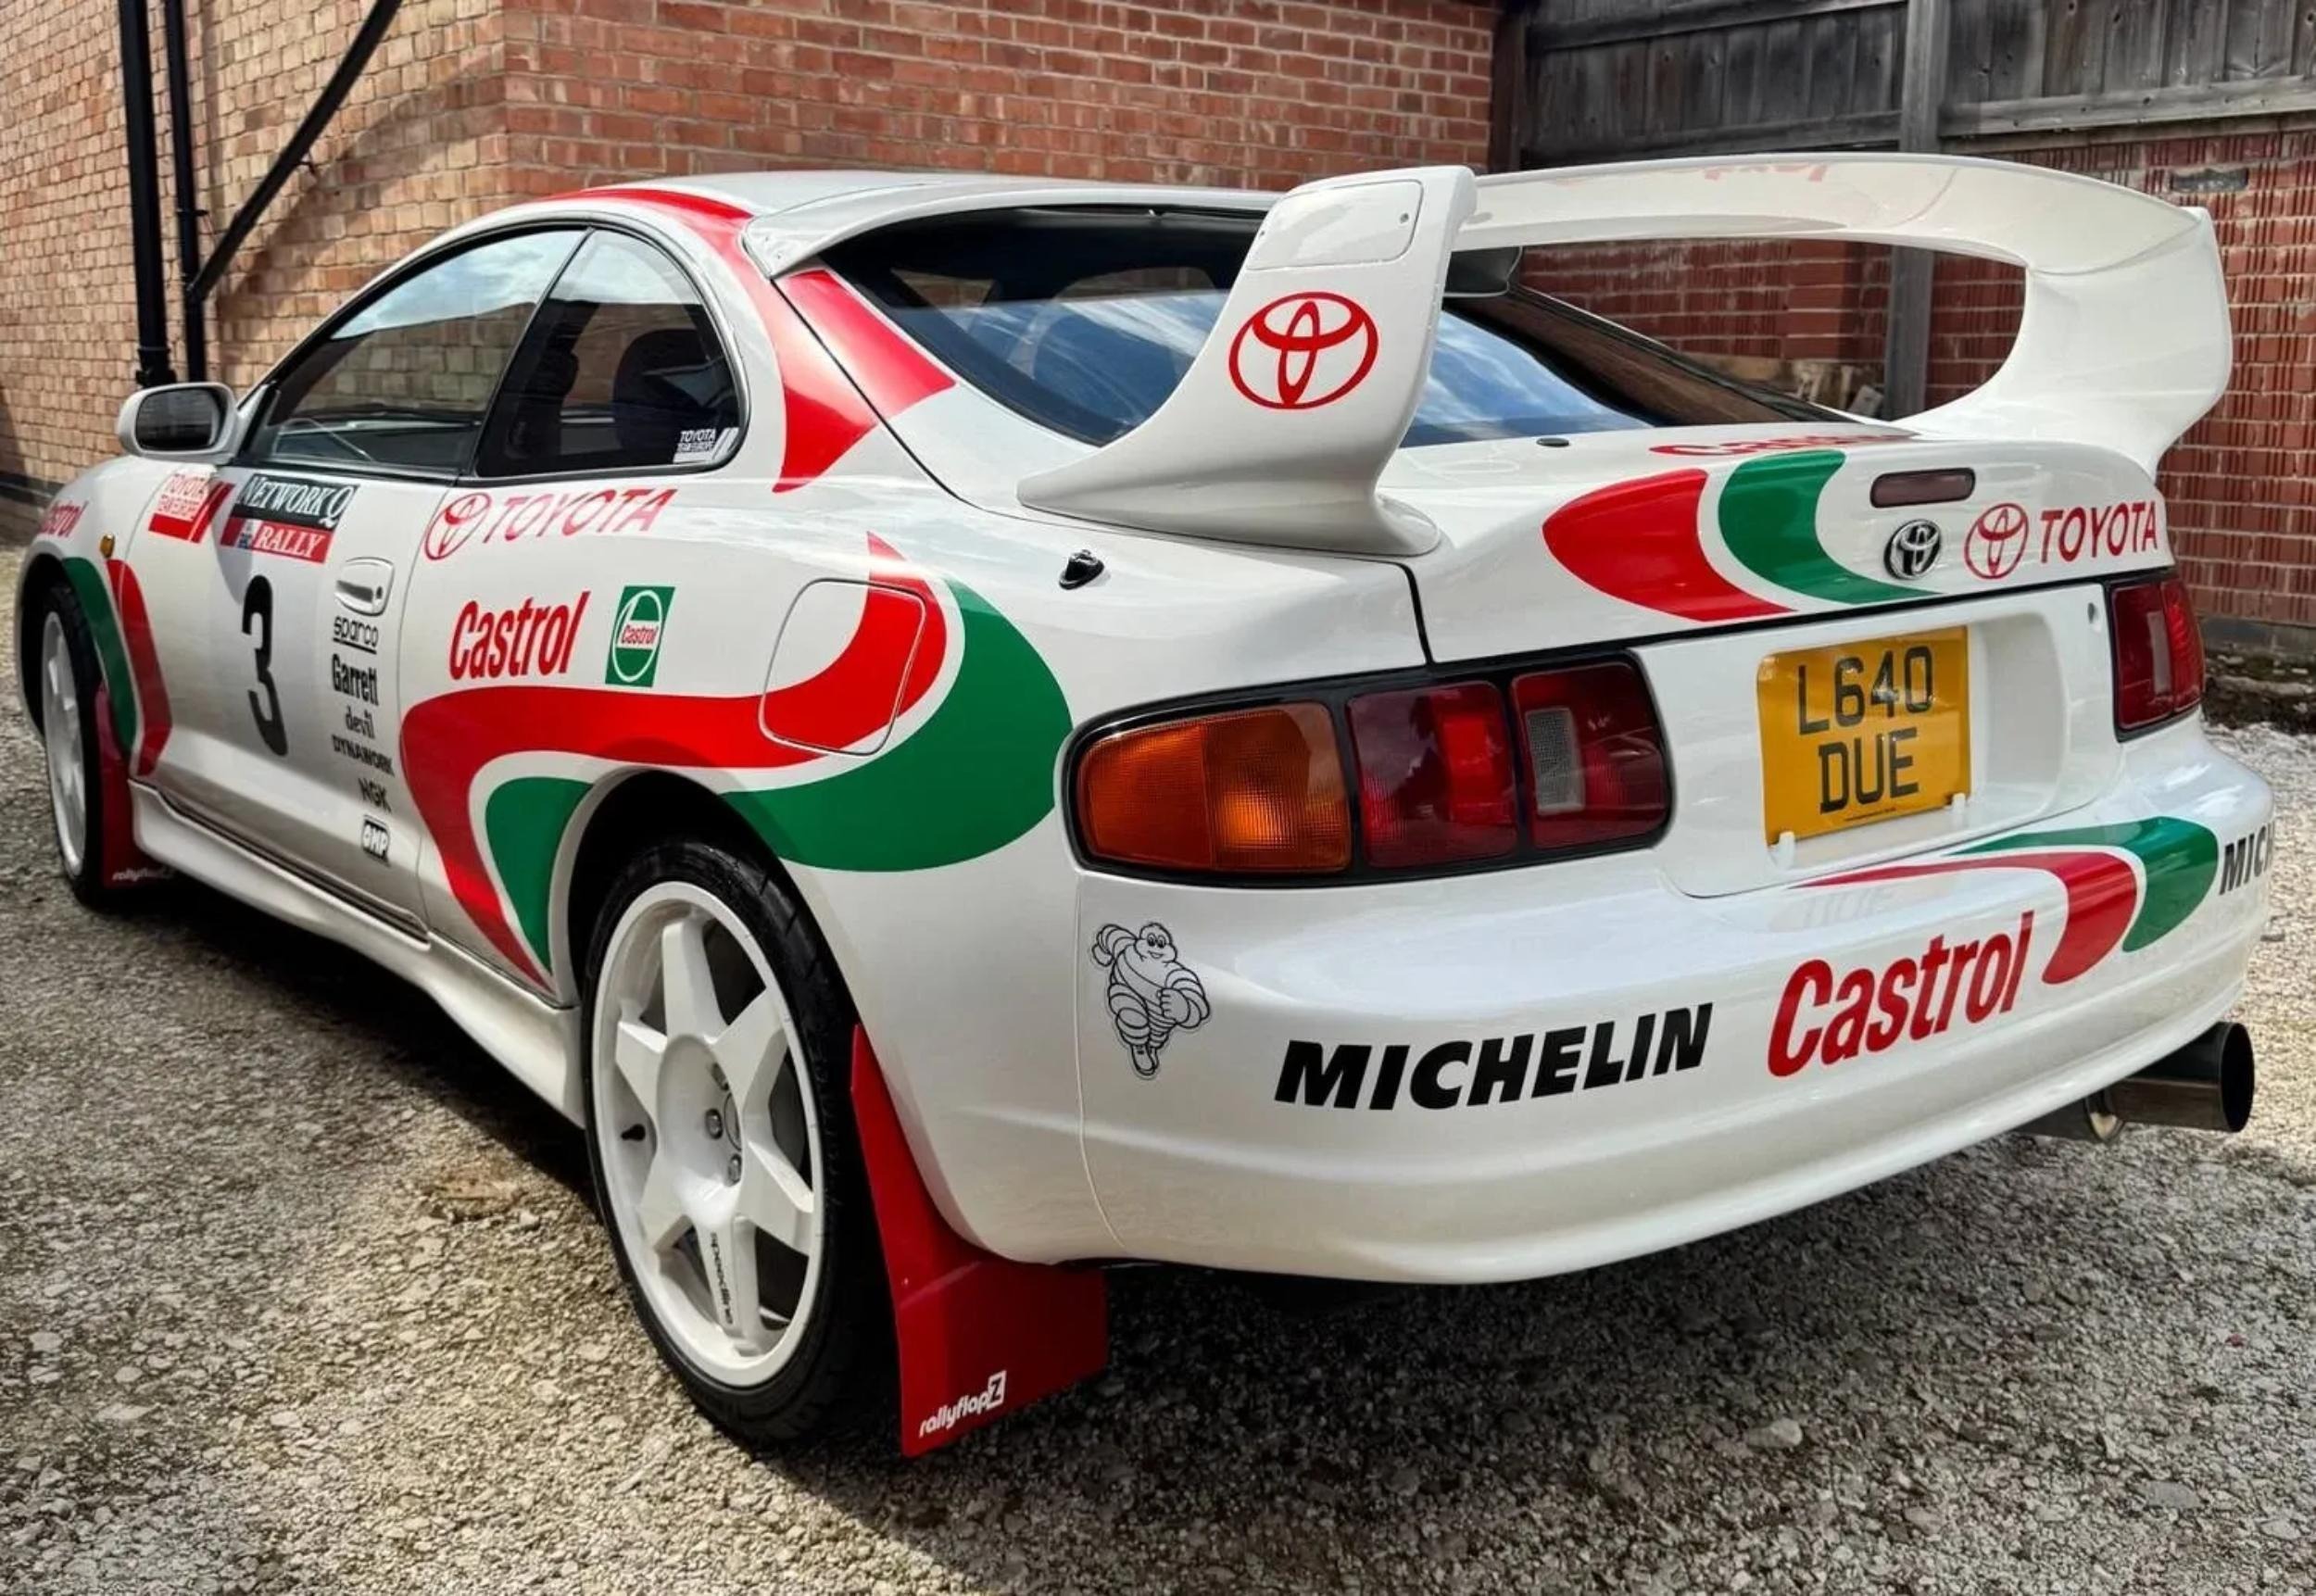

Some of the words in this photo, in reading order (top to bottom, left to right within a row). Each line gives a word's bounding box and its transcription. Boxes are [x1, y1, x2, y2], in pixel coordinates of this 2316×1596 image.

[680, 428, 716, 443] TOYOTA
[237, 475, 336, 516] NETWORK
[319, 484, 356, 529] Q
[483, 489, 678, 544] TOYOTA
[253, 524, 326, 558] RALLY
[2040, 500, 2159, 563] TOYOTA
[334, 615, 379, 647] sparco
[449, 591, 591, 681] Castrol
[621, 624, 659, 645] Castrol
[242, 574, 288, 757] 3
[332, 653, 379, 706] Garrett
[1798, 646, 1933, 735] L640
[346, 705, 375, 739] devil
[358, 776, 392, 813] NGK
[1818, 726, 1920, 815] DUE
[362, 821, 389, 858] OMP
[1768, 910, 2034, 1077] Castrol
[1274, 1002, 1714, 1111] MICHELIN
[919, 1369, 1007, 1439] rallyflapZ
